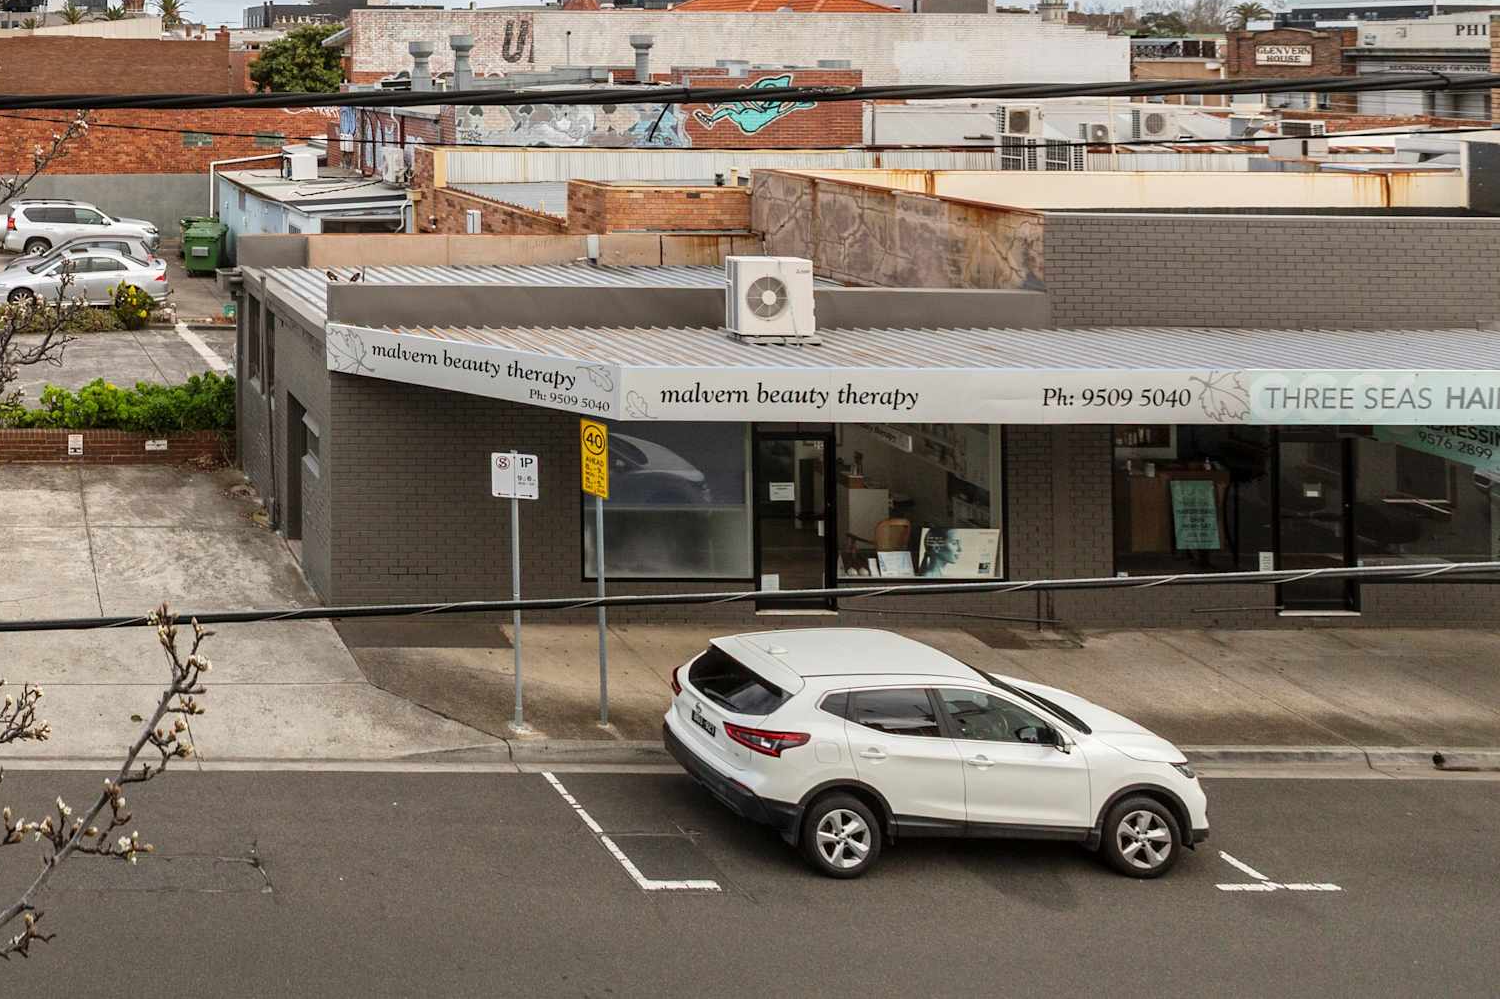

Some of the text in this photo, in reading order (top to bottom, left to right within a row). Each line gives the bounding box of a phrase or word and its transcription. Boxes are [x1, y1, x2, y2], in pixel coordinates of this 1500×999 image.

[1455, 24, 1487, 36] PHI
[1266, 55, 1301, 63] HOUSE
[372, 343, 576, 390] malvern beauty therapy
[529, 388, 610, 413] Ph: 9509 5040
[660, 382, 919, 410] malvern beauty therapy
[1042, 387, 1191, 409] Ph: 9509 5040
[1265, 387, 1354, 409] THREE
[1364, 387, 1433, 409] SEAS
[586, 432, 603, 449] 40
[1418, 431, 1493, 460] 9576 2899
[519, 457, 534, 468] 1P
